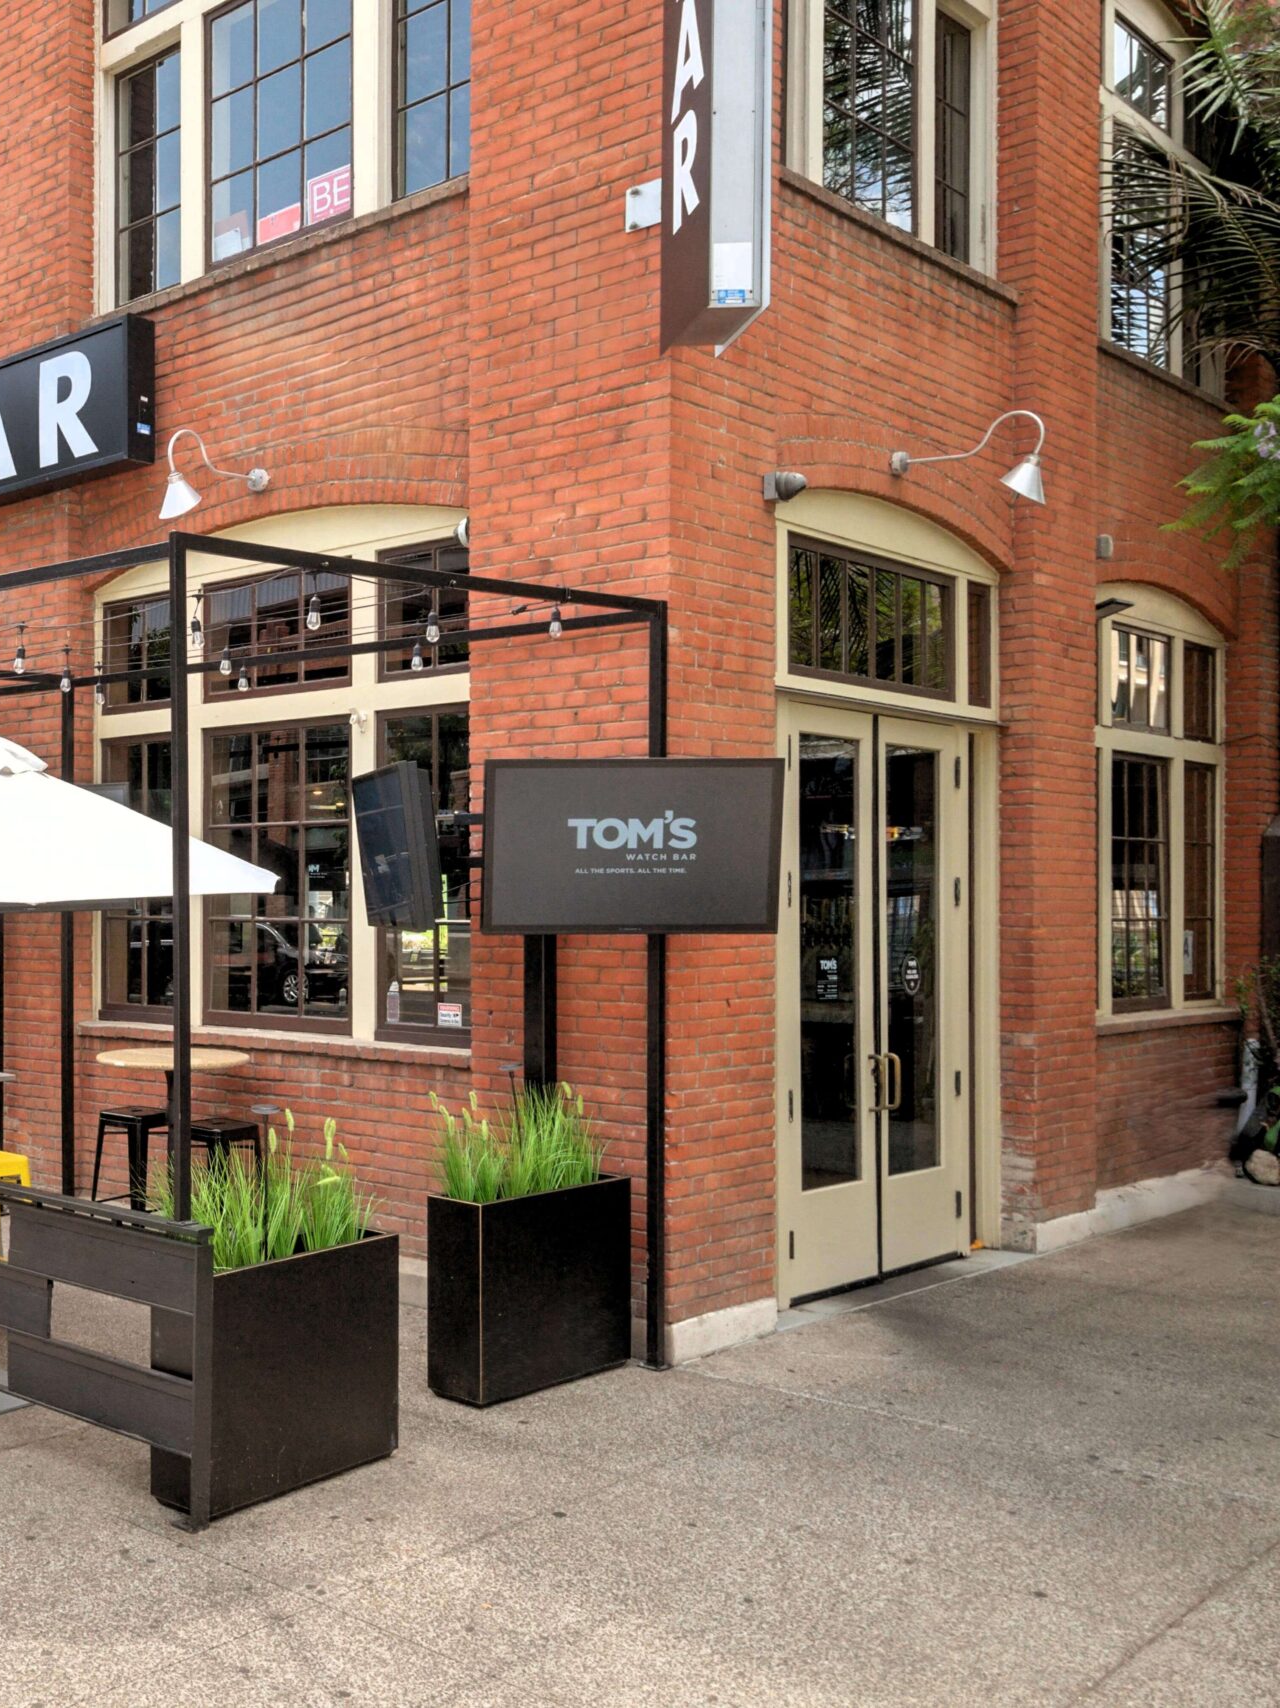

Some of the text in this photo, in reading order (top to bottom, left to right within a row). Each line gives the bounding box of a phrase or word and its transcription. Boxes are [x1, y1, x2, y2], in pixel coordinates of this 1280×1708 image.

[671, 0, 704, 236] AR
[313, 172, 350, 215] BE
[567, 809, 698, 850] TOM'S
[625, 853, 697, 861] WATCH BAR
